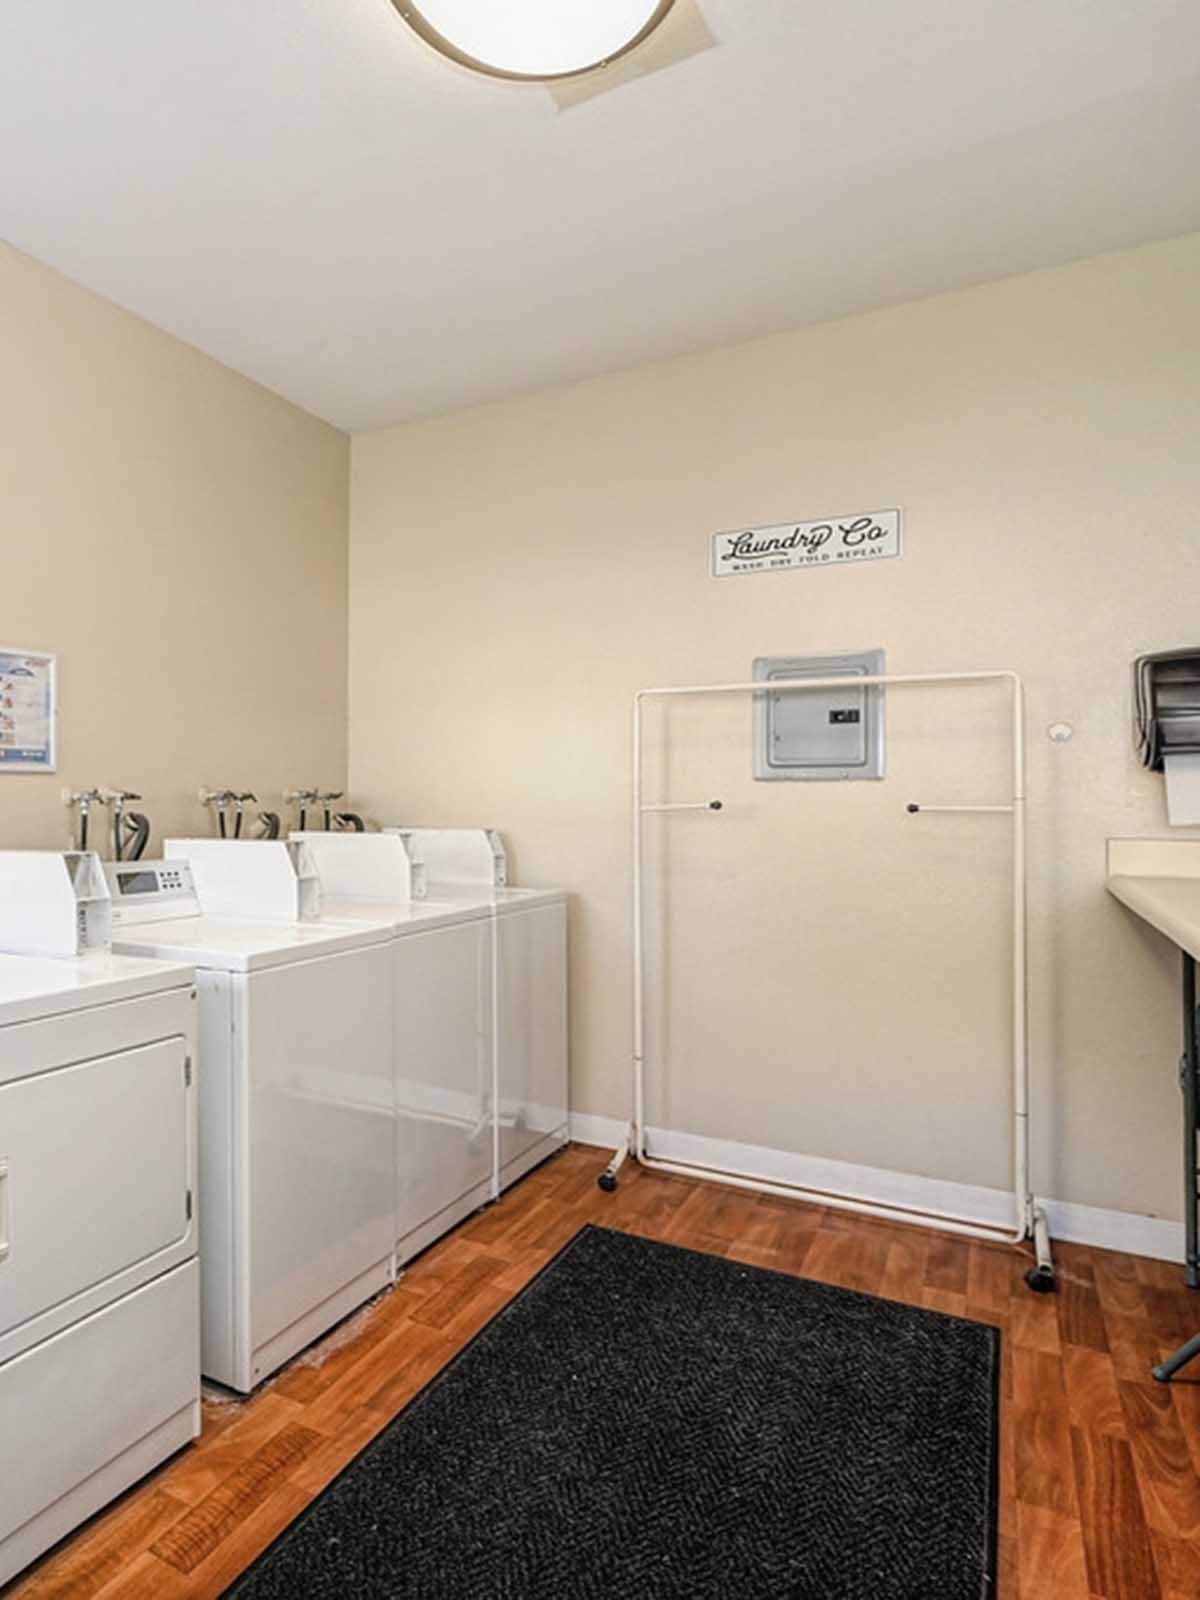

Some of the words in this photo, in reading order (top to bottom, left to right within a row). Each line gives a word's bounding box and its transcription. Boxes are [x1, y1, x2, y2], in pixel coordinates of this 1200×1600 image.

[721, 525, 833, 560] Laundry
[838, 517, 888, 546] Co
[770, 558, 792, 567] DRY
[799, 553, 831, 563] FOLD
[836, 547, 884, 558] REPEAT
